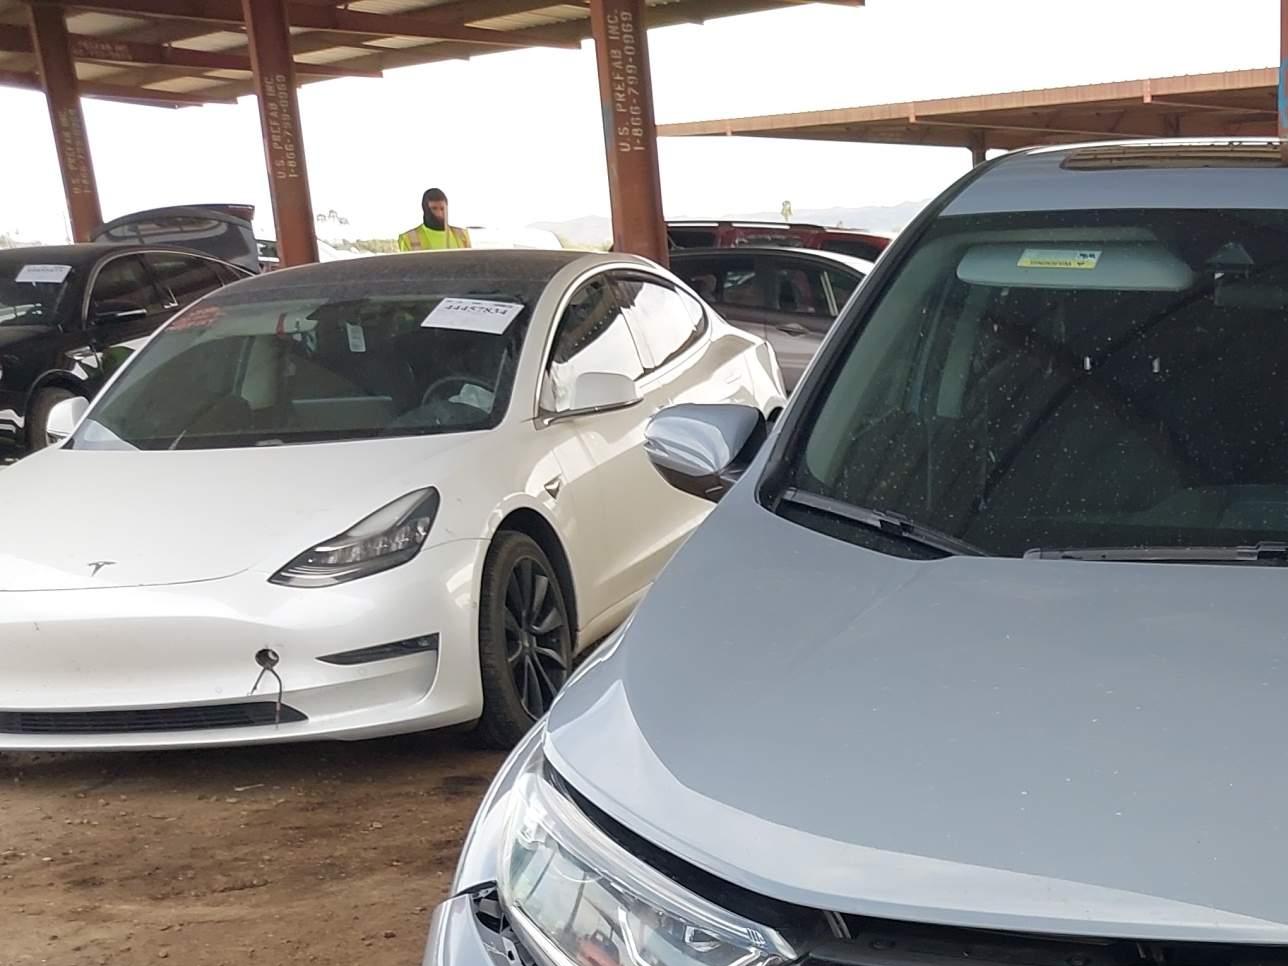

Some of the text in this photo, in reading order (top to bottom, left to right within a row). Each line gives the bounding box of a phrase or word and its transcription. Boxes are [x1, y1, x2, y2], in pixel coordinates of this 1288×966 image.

[606, 9, 632, 152] U.S. PREFAB INC.
[620, 11, 645, 150] 1-866-799-0969
